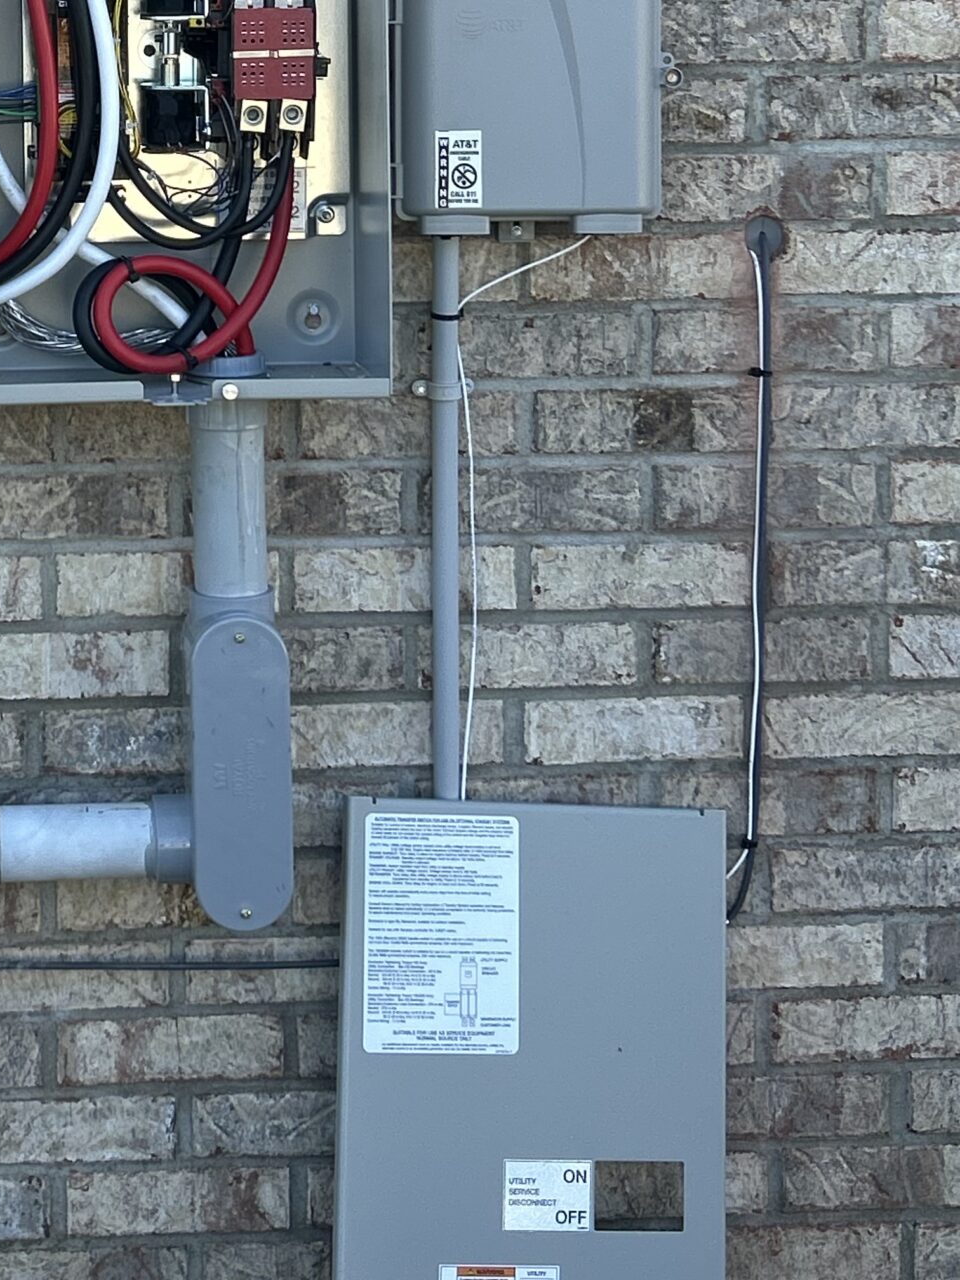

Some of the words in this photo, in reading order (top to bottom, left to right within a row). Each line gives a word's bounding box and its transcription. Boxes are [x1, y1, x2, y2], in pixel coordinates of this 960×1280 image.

[452, 140, 479, 148] AT&T
[439, 138, 448, 208] WARNING
[563, 1169, 587, 1183] ON
[508, 1188, 540, 1196] SERVICE
[508, 1198, 557, 1206] DISCONNECT
[555, 1210, 587, 1224] OFF
